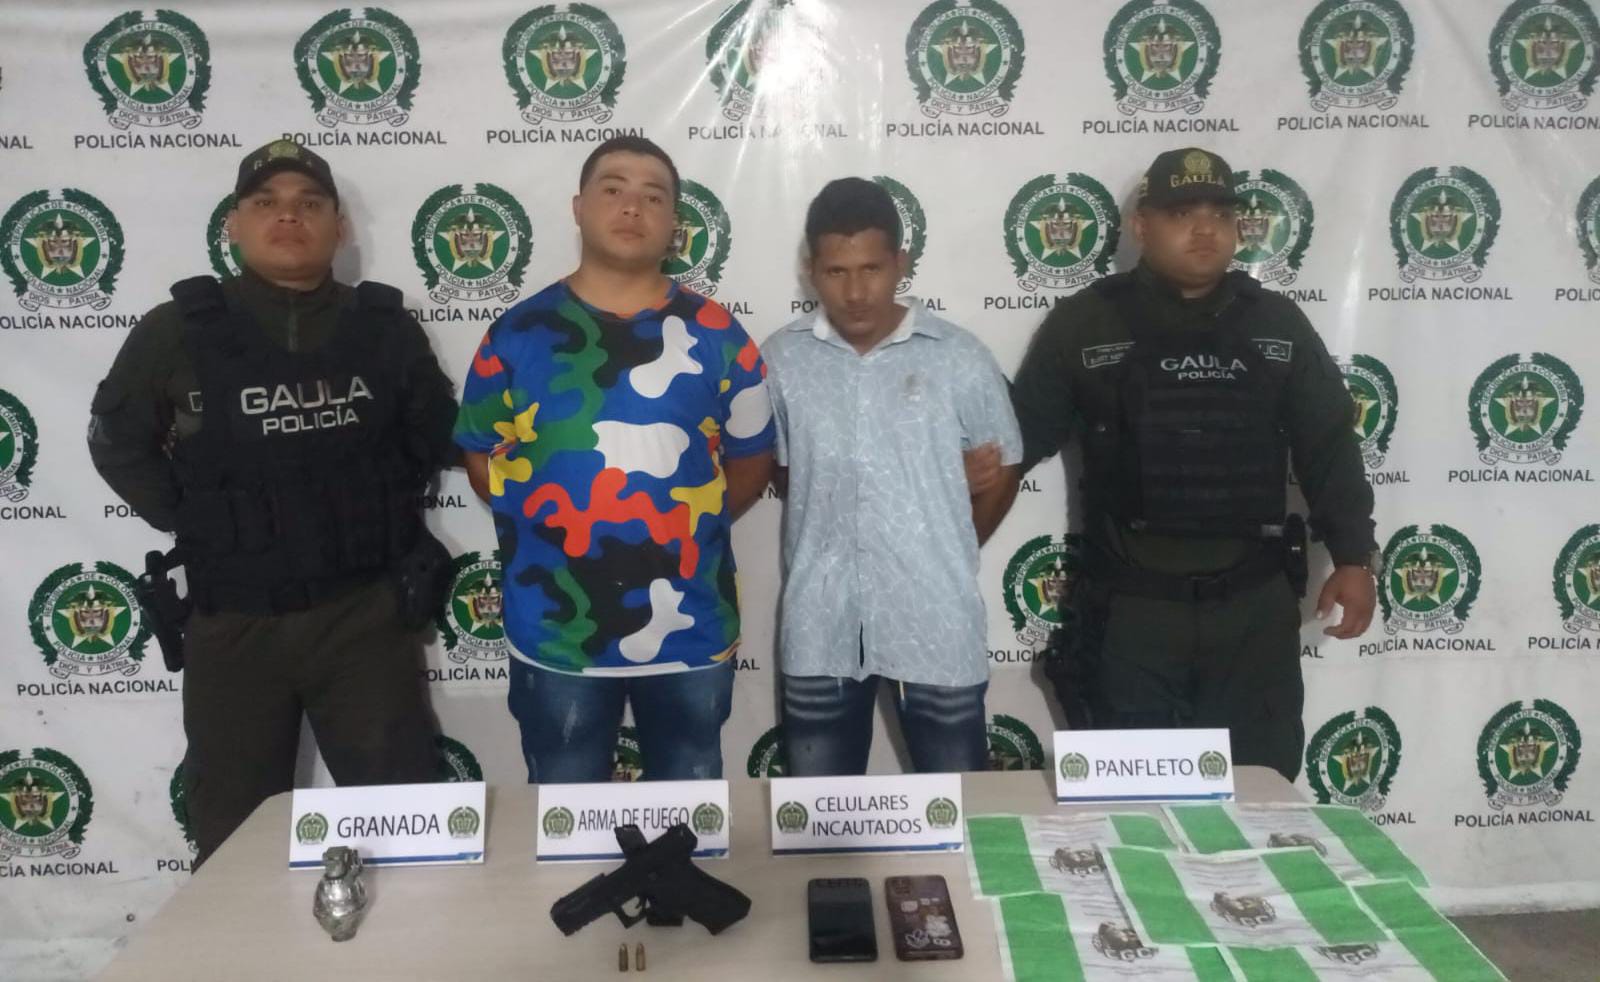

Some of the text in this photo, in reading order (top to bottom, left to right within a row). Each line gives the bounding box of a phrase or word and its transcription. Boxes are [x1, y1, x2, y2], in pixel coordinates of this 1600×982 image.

[887, 120, 1044, 137] POLICÍA NACIONAL
[1083, 118, 1239, 134] POLICÍA NACIONAL
[1278, 114, 1430, 130] POLICÍA NACIONAL
[1468, 112, 1530, 129] POLICÍA
[75, 132, 243, 149] POLICÍA NACIONAL
[357, 131, 447, 146] NACIONAL
[487, 126, 556, 143] POLICÍA
[1056, 185, 1067, 193] DE
[51, 200, 62, 208] DE
[463, 195, 477, 203] DE
[984, 293, 1050, 310] POLICÍA
[1368, 285, 1513, 301] POLICÍA NACIONAL
[60, 314, 145, 329] NACIONA
[1160, 354, 1248, 372] GAULA
[1177, 370, 1236, 381] POLICÍA
[240, 376, 374, 415] GAULA
[262, 405, 360, 436] POLICÍA
[1448, 467, 1595, 482] POLICÍA NACIONAL
[1359, 635, 1496, 657] POLICÍA NACIONAL
[1528, 634, 1591, 649] POLICÍA
[17, 679, 179, 697] POLICÍA NACIONAL
[1095, 758, 1194, 777] PANFLETO
[815, 795, 909, 812] CELULARES
[337, 813, 440, 839] GRANADA
[578, 807, 689, 830] ARMA DE FUEGO
[812, 818, 922, 836] INCAUTADOS
[1455, 810, 1595, 828] POLICÍA NACIONAL
[31, 861, 119, 876] NACIONAL
